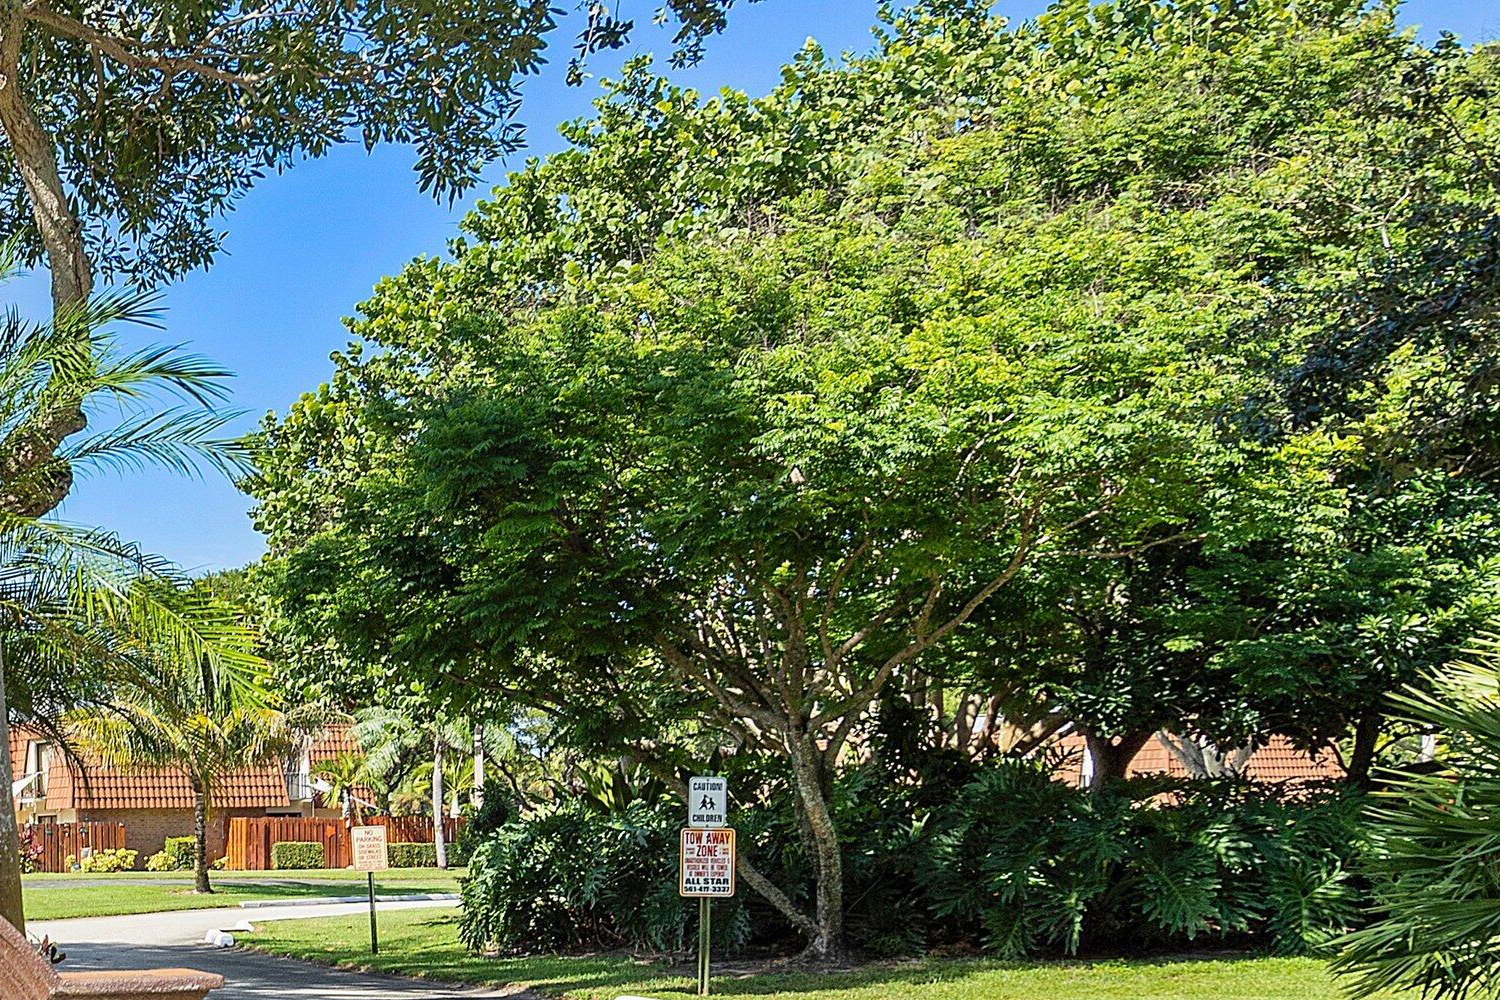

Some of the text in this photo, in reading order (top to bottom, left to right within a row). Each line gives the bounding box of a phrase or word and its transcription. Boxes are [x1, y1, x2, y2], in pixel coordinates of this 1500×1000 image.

[693, 782, 723, 790] CAUTION!
[692, 814, 722, 822] CHILDREN
[685, 832, 730, 844] TOW AWAY
[697, 845, 718, 857] ZONE
